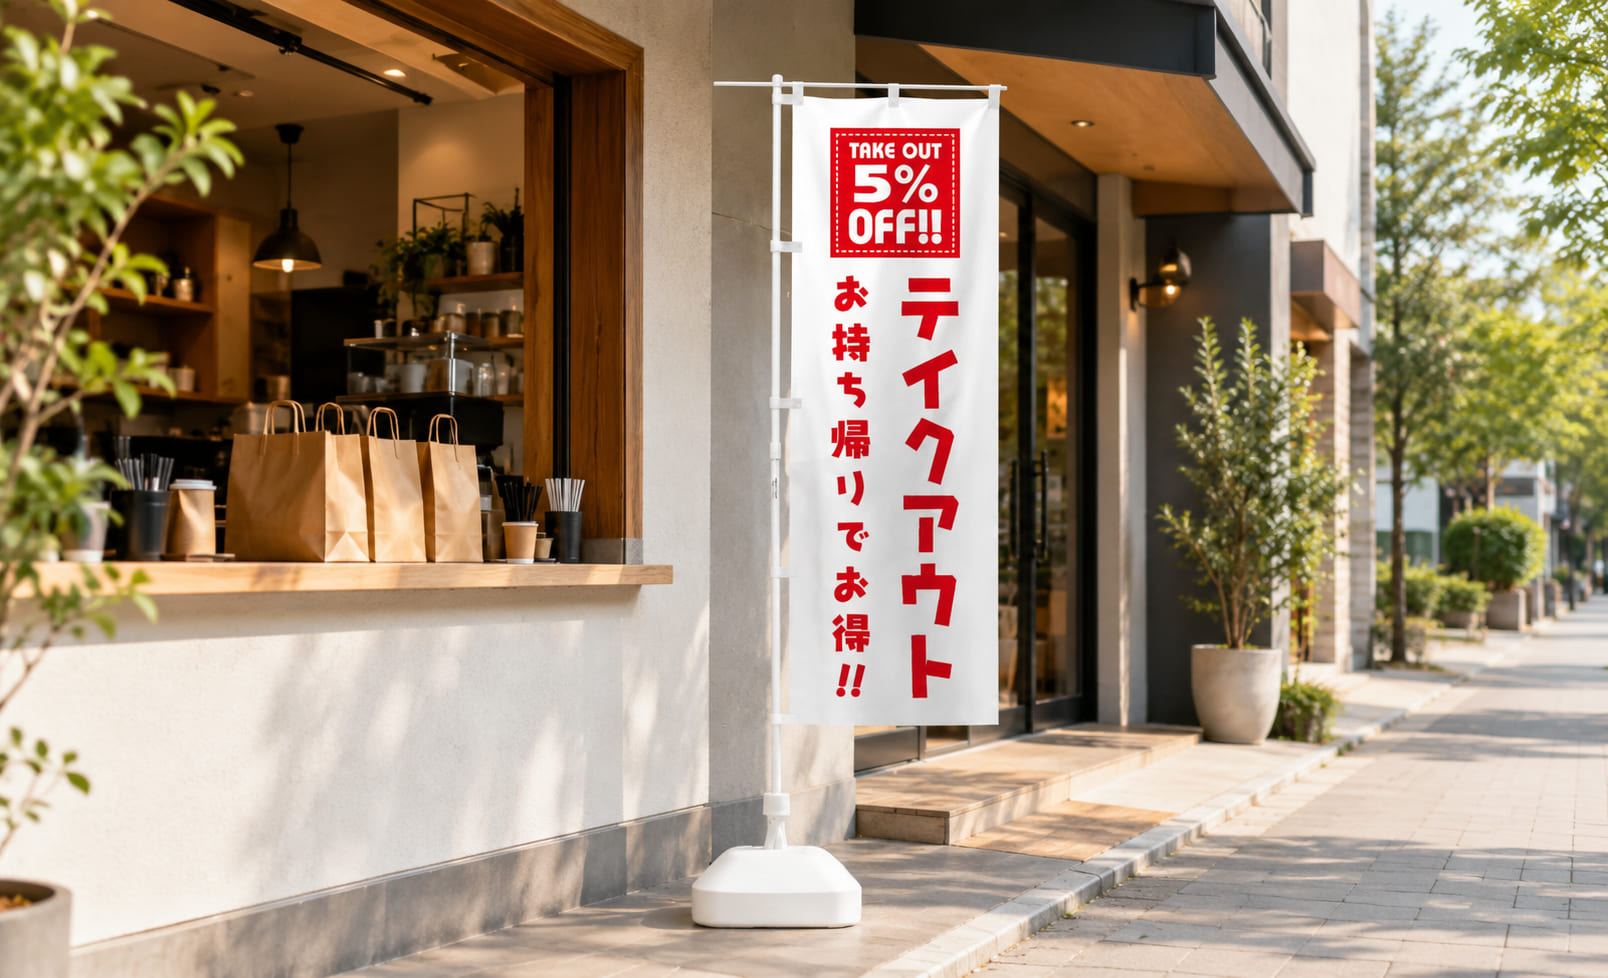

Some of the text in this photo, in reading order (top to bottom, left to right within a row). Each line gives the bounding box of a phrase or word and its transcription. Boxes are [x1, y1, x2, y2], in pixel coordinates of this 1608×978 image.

[849, 142, 942, 159] TAKE OUT
[853, 164, 938, 204] 5%
[848, 208, 942, 245] OFF!!
[831, 275, 871, 698] お持ち帰りでお得!!
[901, 277, 959, 698] テイクアウト
